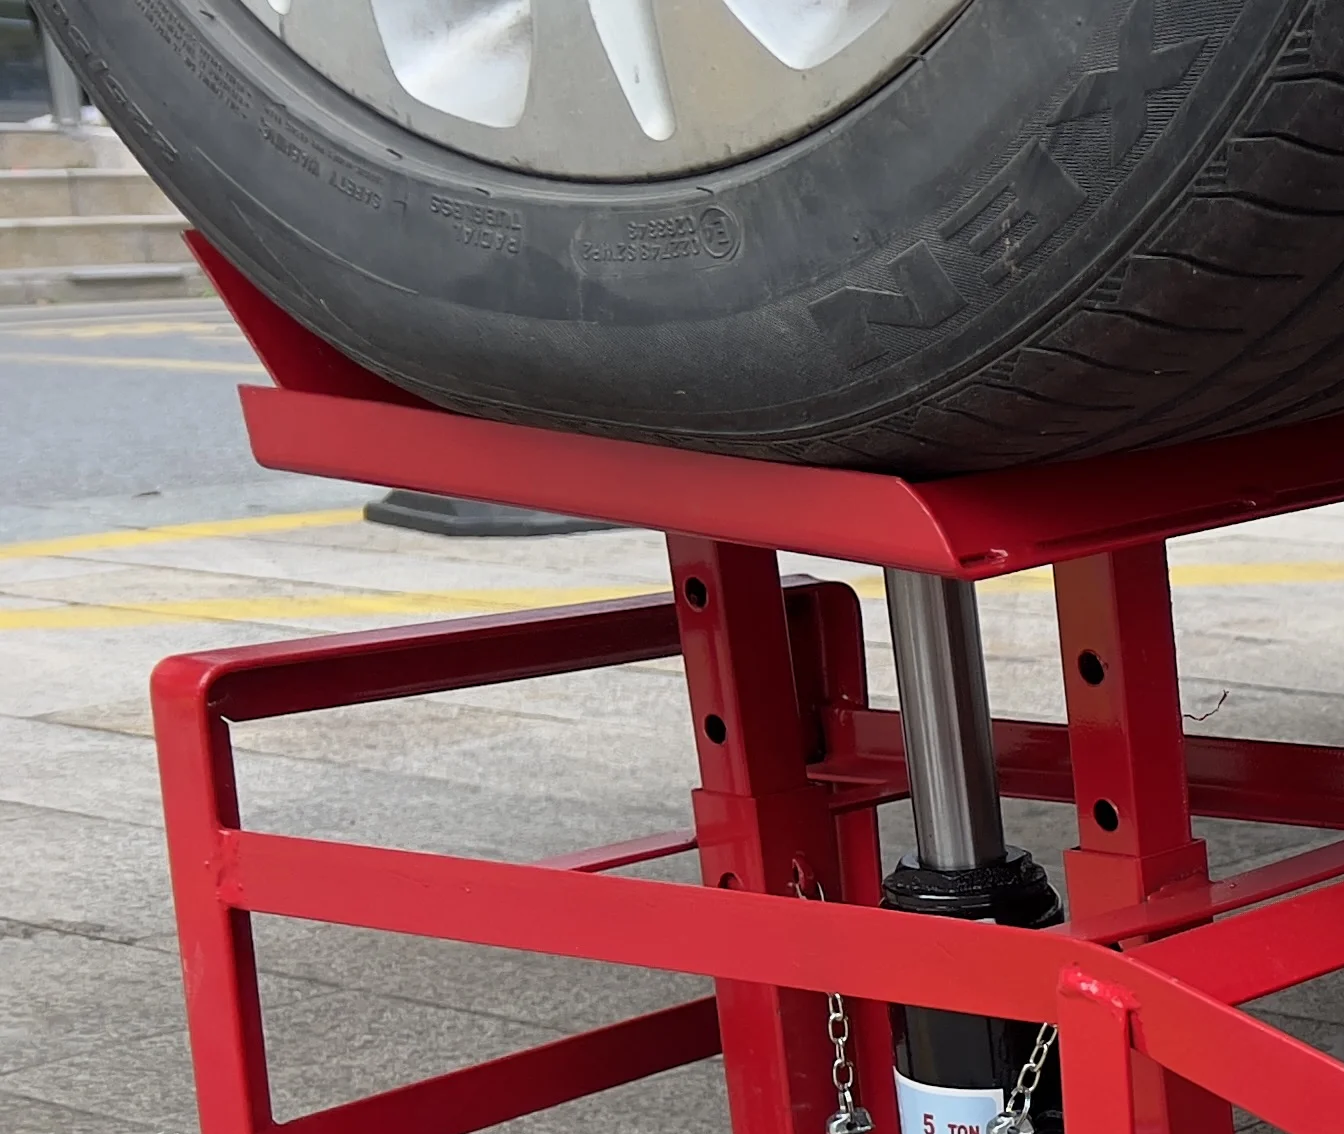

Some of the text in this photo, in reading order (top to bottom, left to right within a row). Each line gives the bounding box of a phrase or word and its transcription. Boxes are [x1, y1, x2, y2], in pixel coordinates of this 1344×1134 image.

[430, 193, 522, 230] TUBELESS
[453, 222, 520, 254] RADIAL
[700, 216, 731, 246] E4
